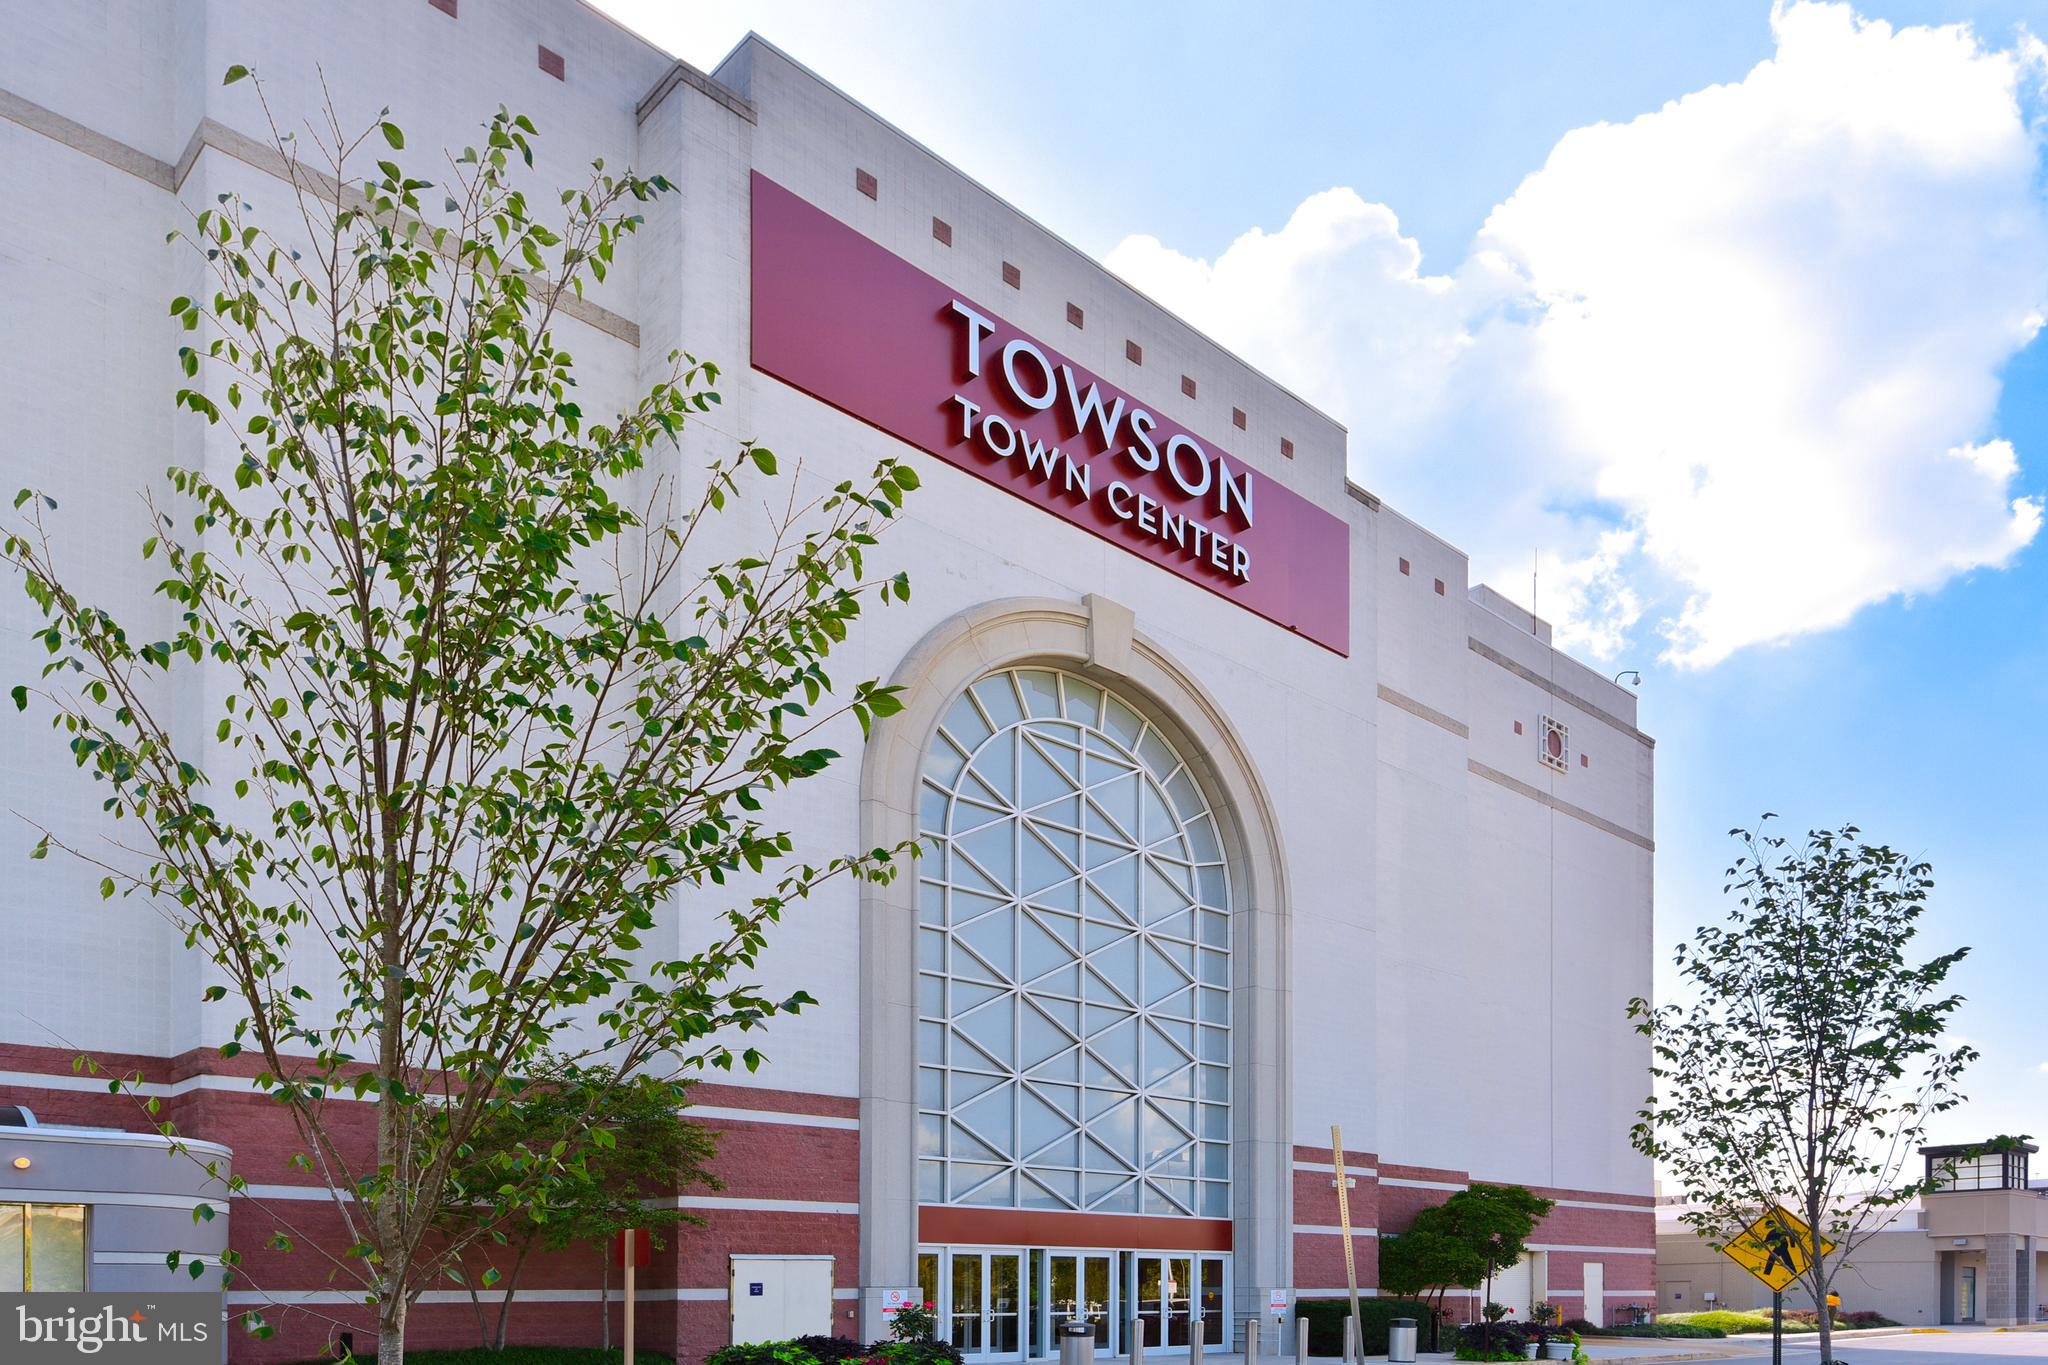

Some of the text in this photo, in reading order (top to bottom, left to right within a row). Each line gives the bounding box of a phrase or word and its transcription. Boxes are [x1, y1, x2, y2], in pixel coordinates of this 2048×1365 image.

[952, 298, 1253, 529] TOWSON
[954, 393, 1251, 583] TOWN CENTER
